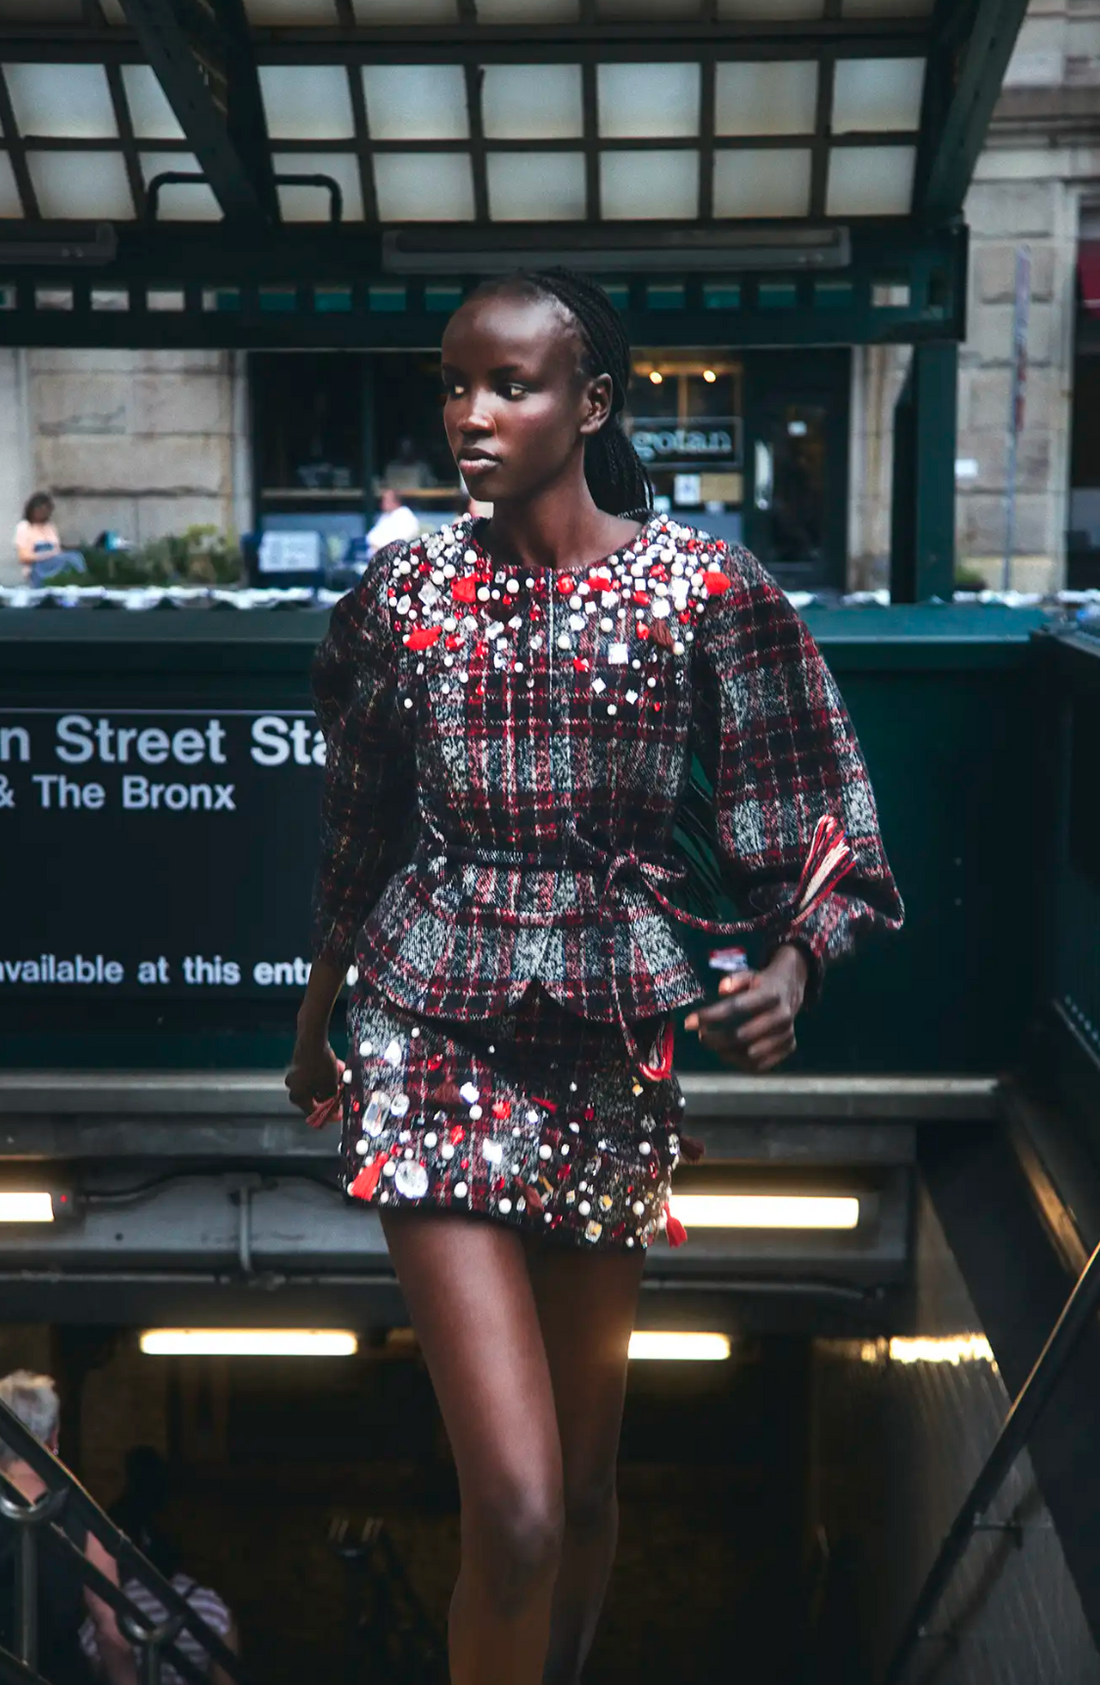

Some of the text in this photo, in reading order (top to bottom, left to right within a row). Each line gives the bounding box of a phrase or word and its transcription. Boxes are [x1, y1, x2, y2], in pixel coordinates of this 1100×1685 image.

[55, 715, 227, 764] Street
[0, 774, 236, 810] & The Bronx
[137, 956, 169, 984] at
[183, 954, 241, 985] this
